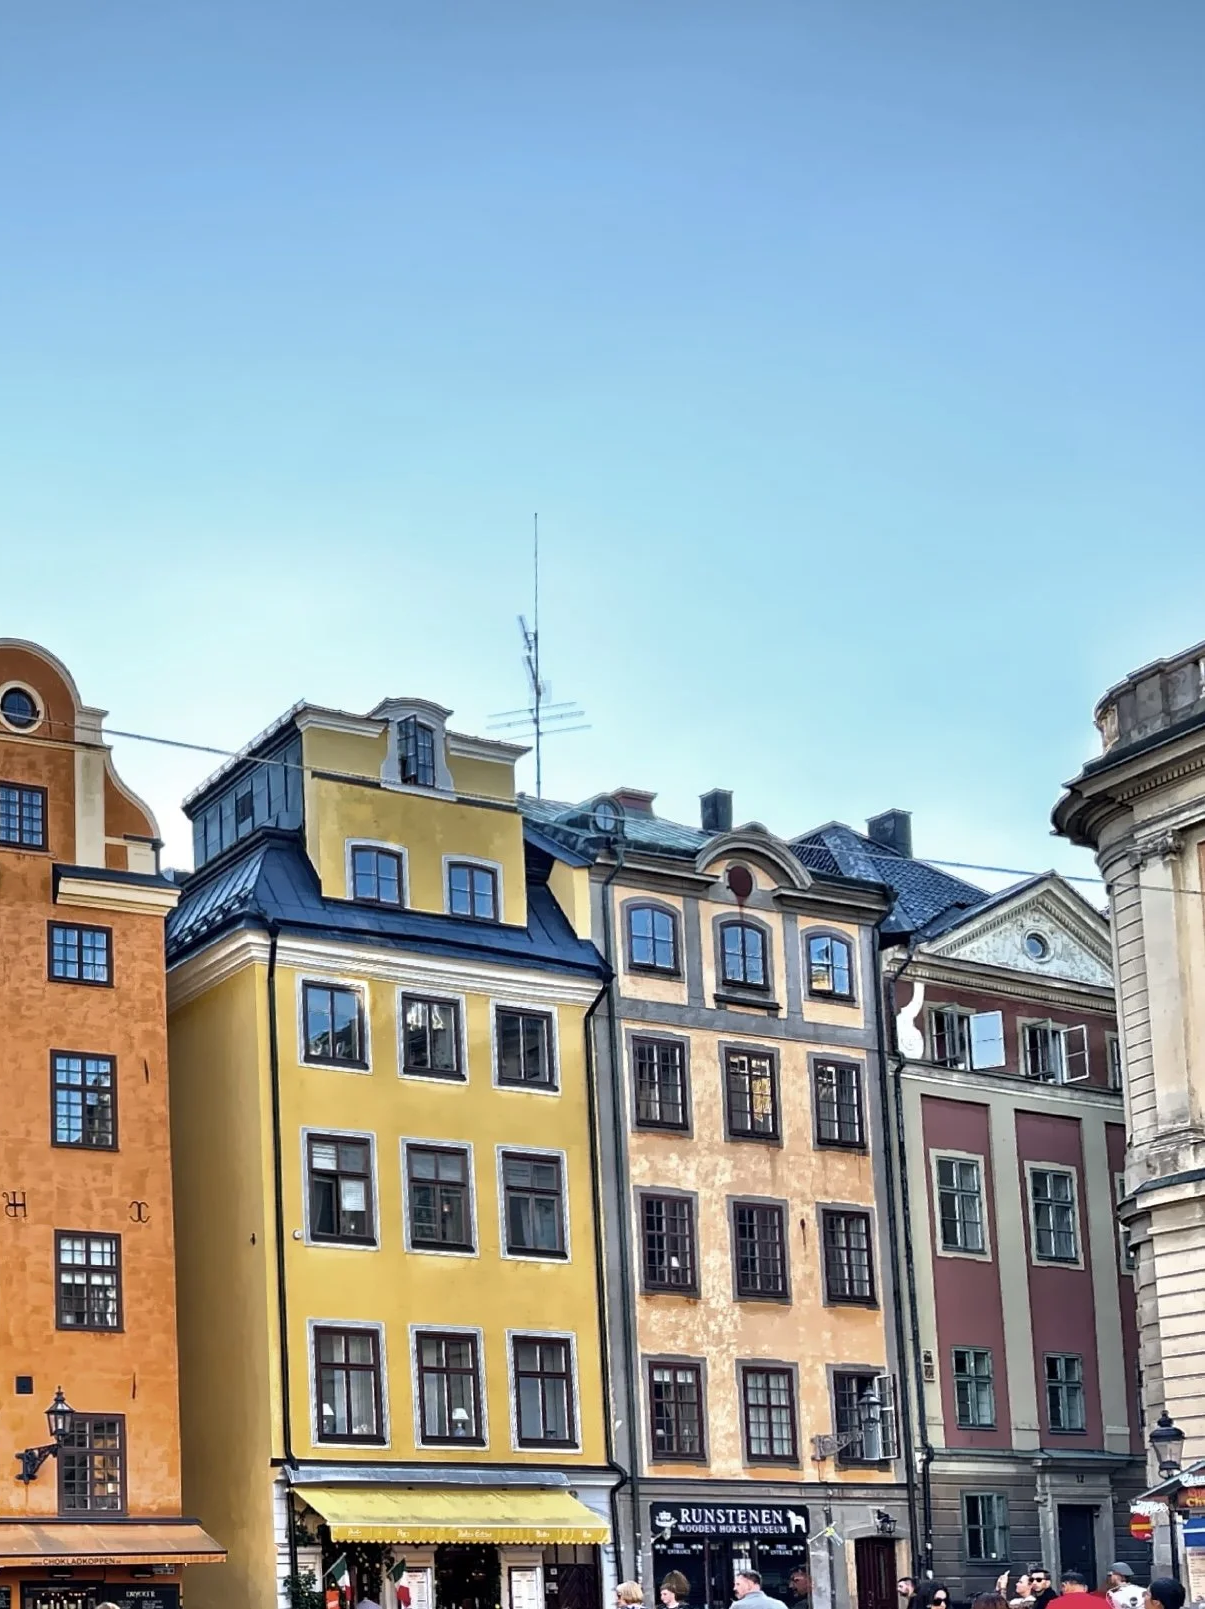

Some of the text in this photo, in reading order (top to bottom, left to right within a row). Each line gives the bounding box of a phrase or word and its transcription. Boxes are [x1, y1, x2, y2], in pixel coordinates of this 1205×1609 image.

[680, 1508, 783, 1525] RUNSTENEN
[678, 1525, 788, 1534] WOODEN HORSE MUSEUM
[43, 1557, 115, 1565] CHOKLADKOPPEN
